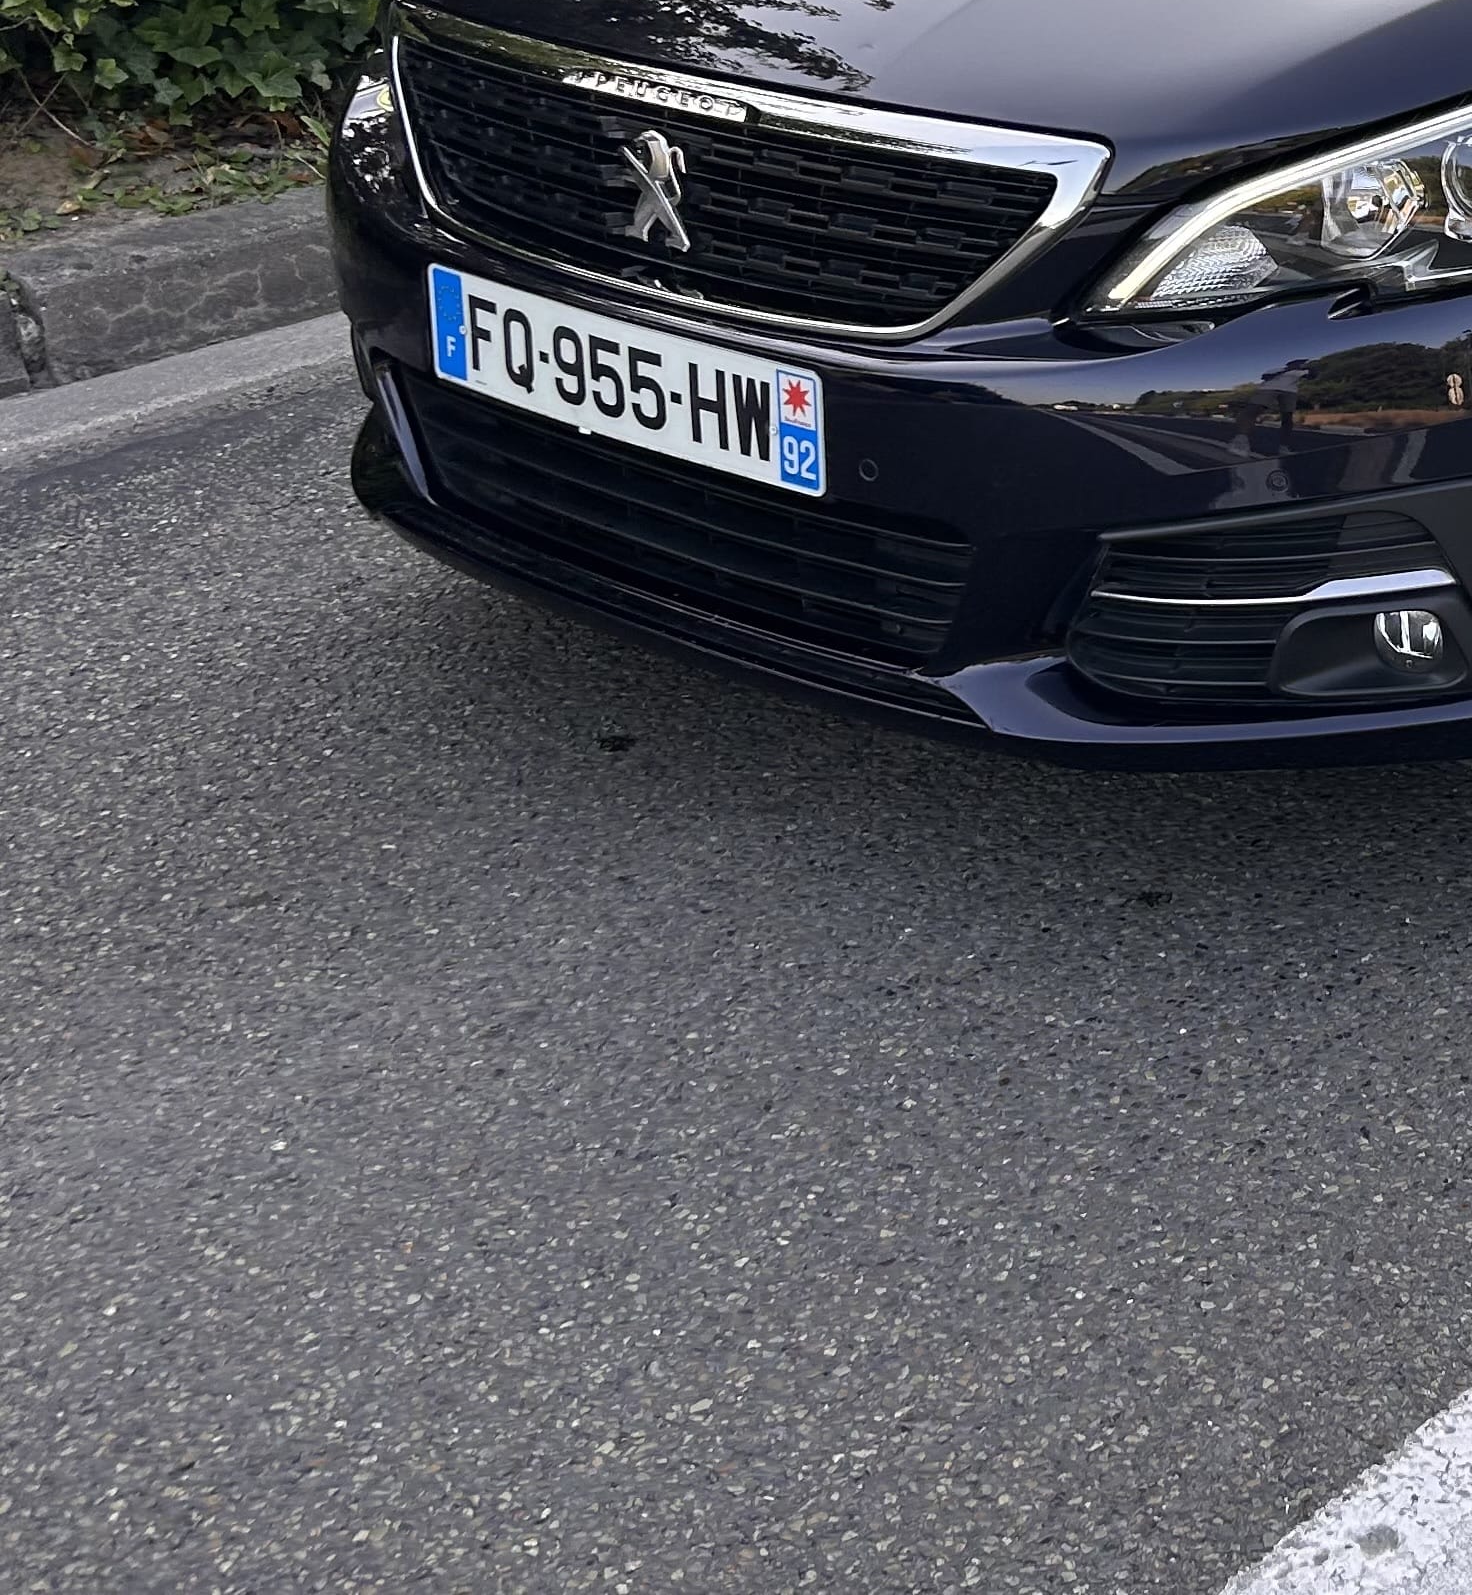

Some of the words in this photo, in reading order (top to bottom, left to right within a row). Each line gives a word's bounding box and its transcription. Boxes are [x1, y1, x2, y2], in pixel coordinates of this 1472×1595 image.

[446, 335, 456, 357] F
[468, 294, 771, 462] FQ-955-HW
[783, 435, 817, 481] 92
